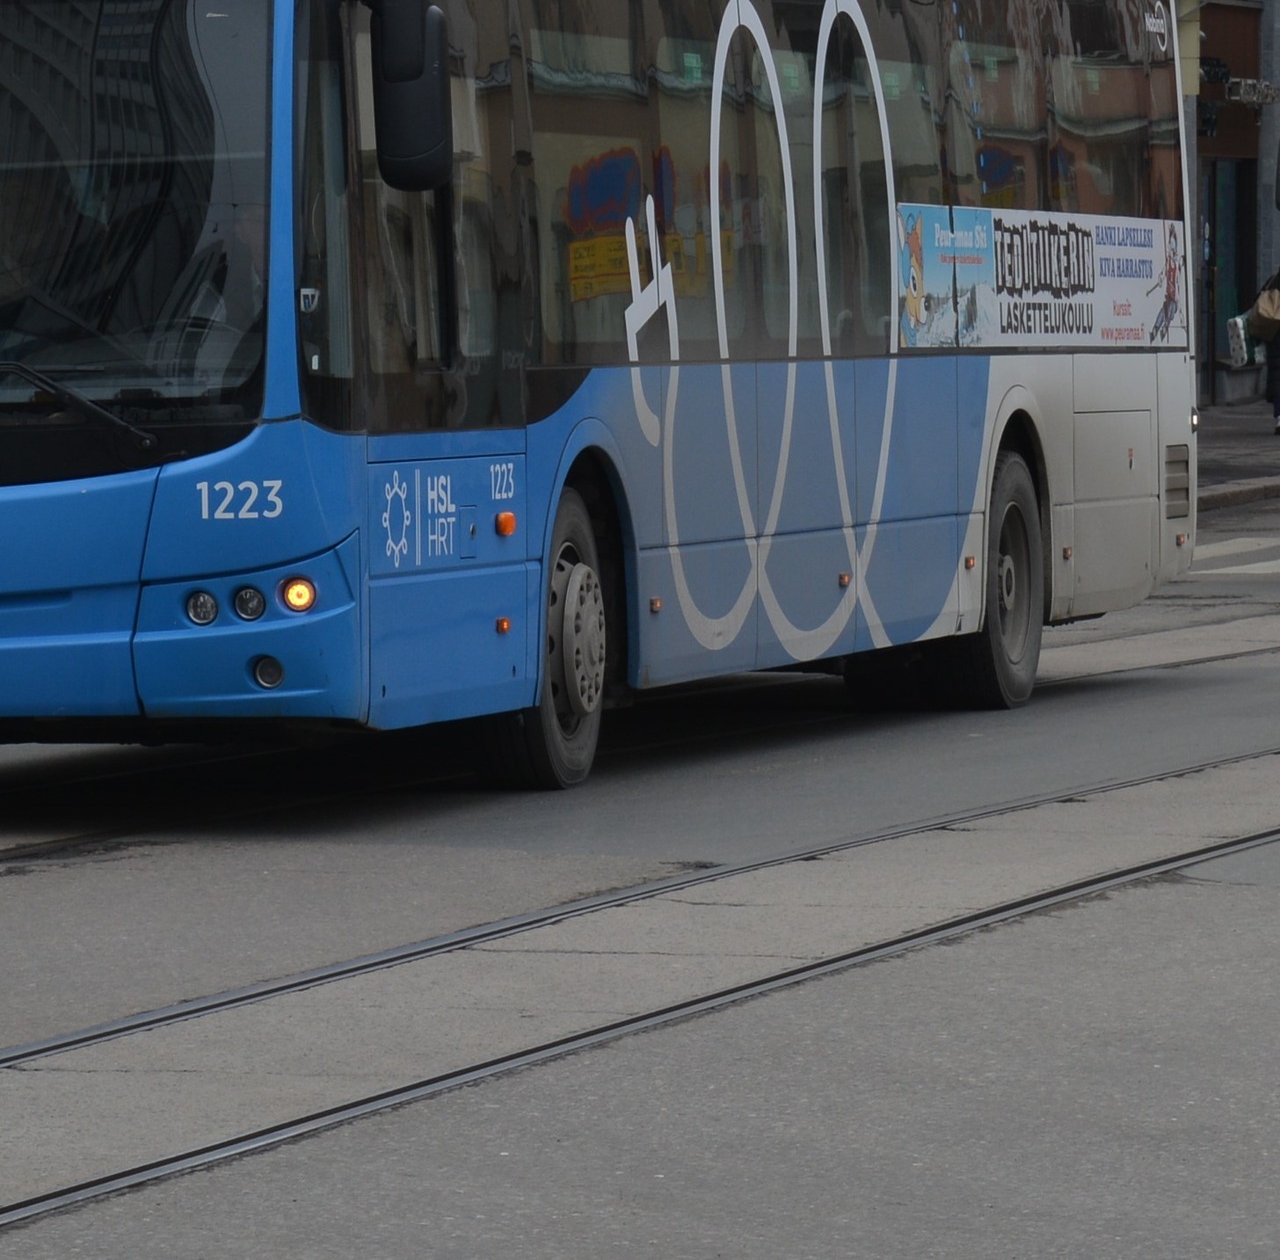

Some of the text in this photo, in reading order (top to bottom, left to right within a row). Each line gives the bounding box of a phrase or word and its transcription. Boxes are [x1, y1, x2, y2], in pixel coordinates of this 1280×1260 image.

[1144, 12, 1165, 34] Nobina
[1095, 226, 1153, 248] HANKI LAPSELLESI
[1100, 257, 1153, 279] KIVA HARRASTUS
[1000, 302, 1094, 334] LASKETTELUKOULU
[428, 475, 456, 514] HSL
[490, 463, 514, 500] 1223
[196, 480, 283, 519] 1223
[428, 517, 456, 557] HRT
